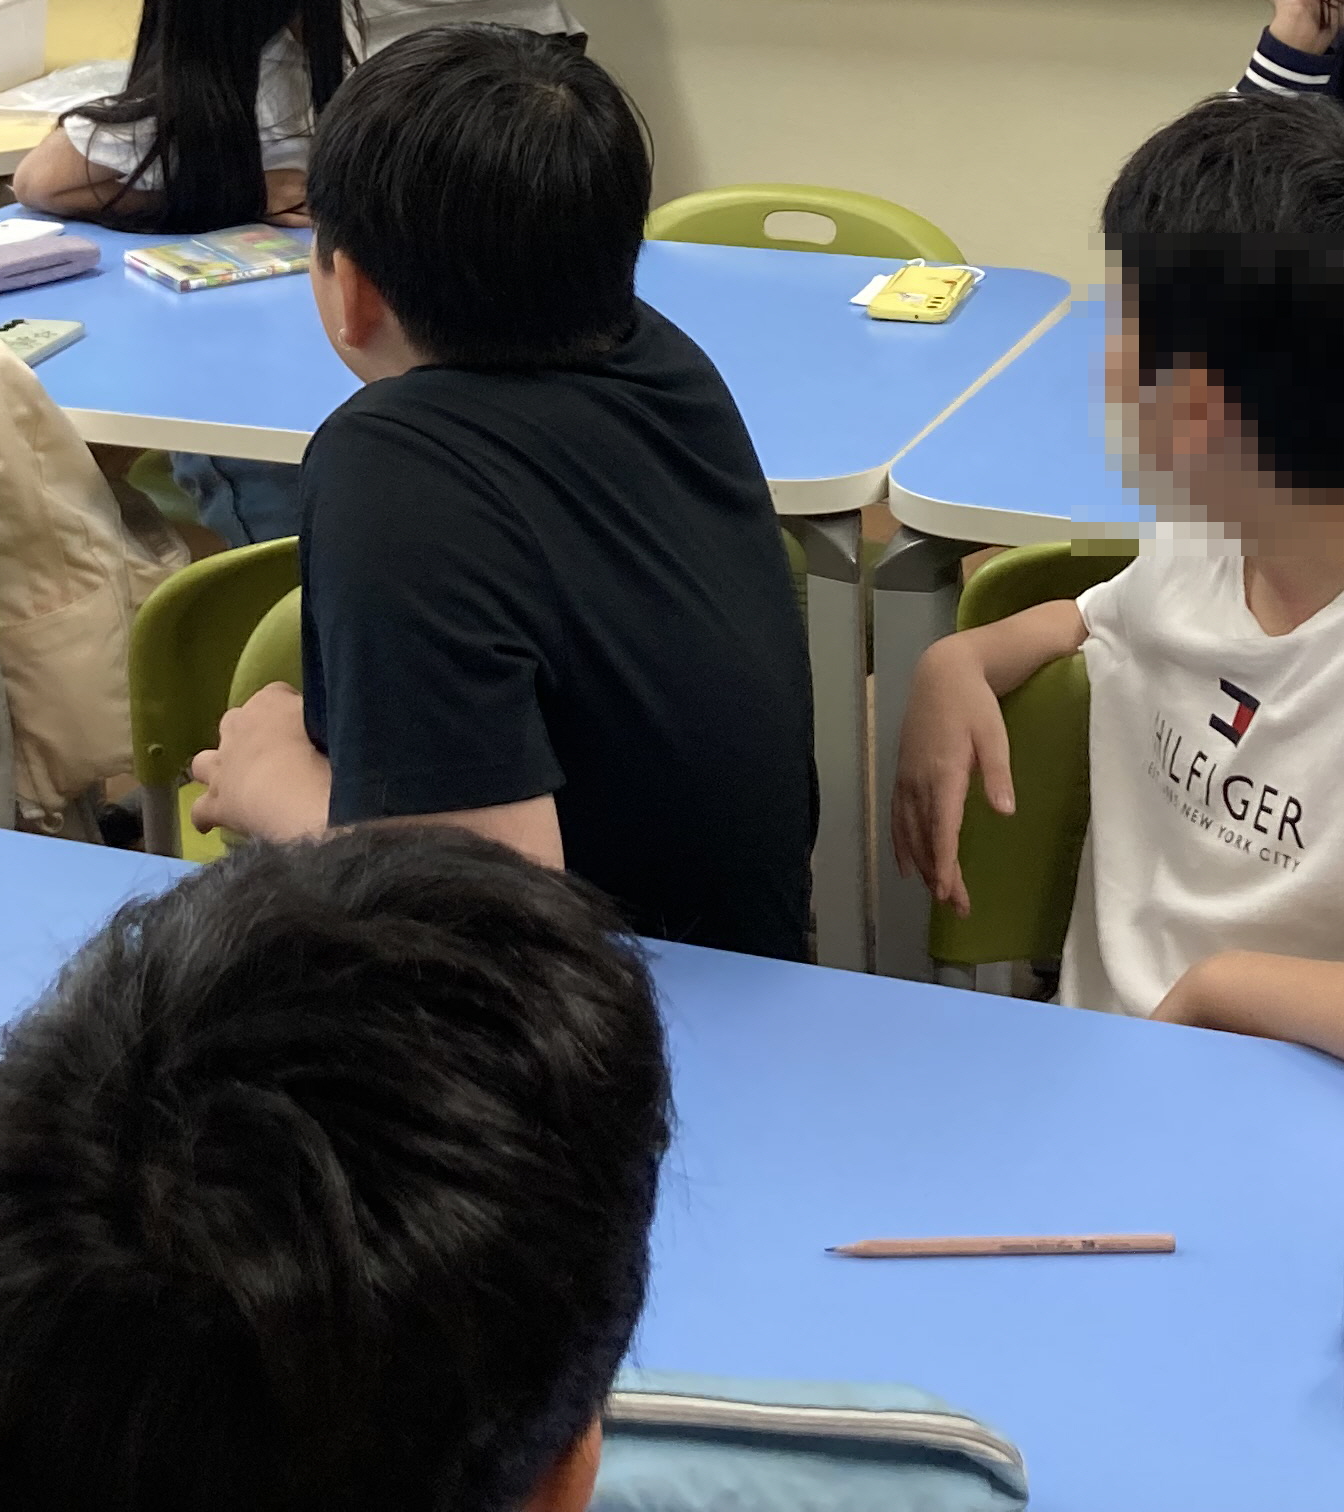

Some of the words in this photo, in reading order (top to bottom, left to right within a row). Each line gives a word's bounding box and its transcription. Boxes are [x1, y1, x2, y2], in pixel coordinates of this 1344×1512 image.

[1152, 712, 1306, 850] HILFIGER
[1181, 803, 1214, 831] NEW
[1217, 826, 1253, 854] YORK
[1259, 847, 1301, 873] CITY
